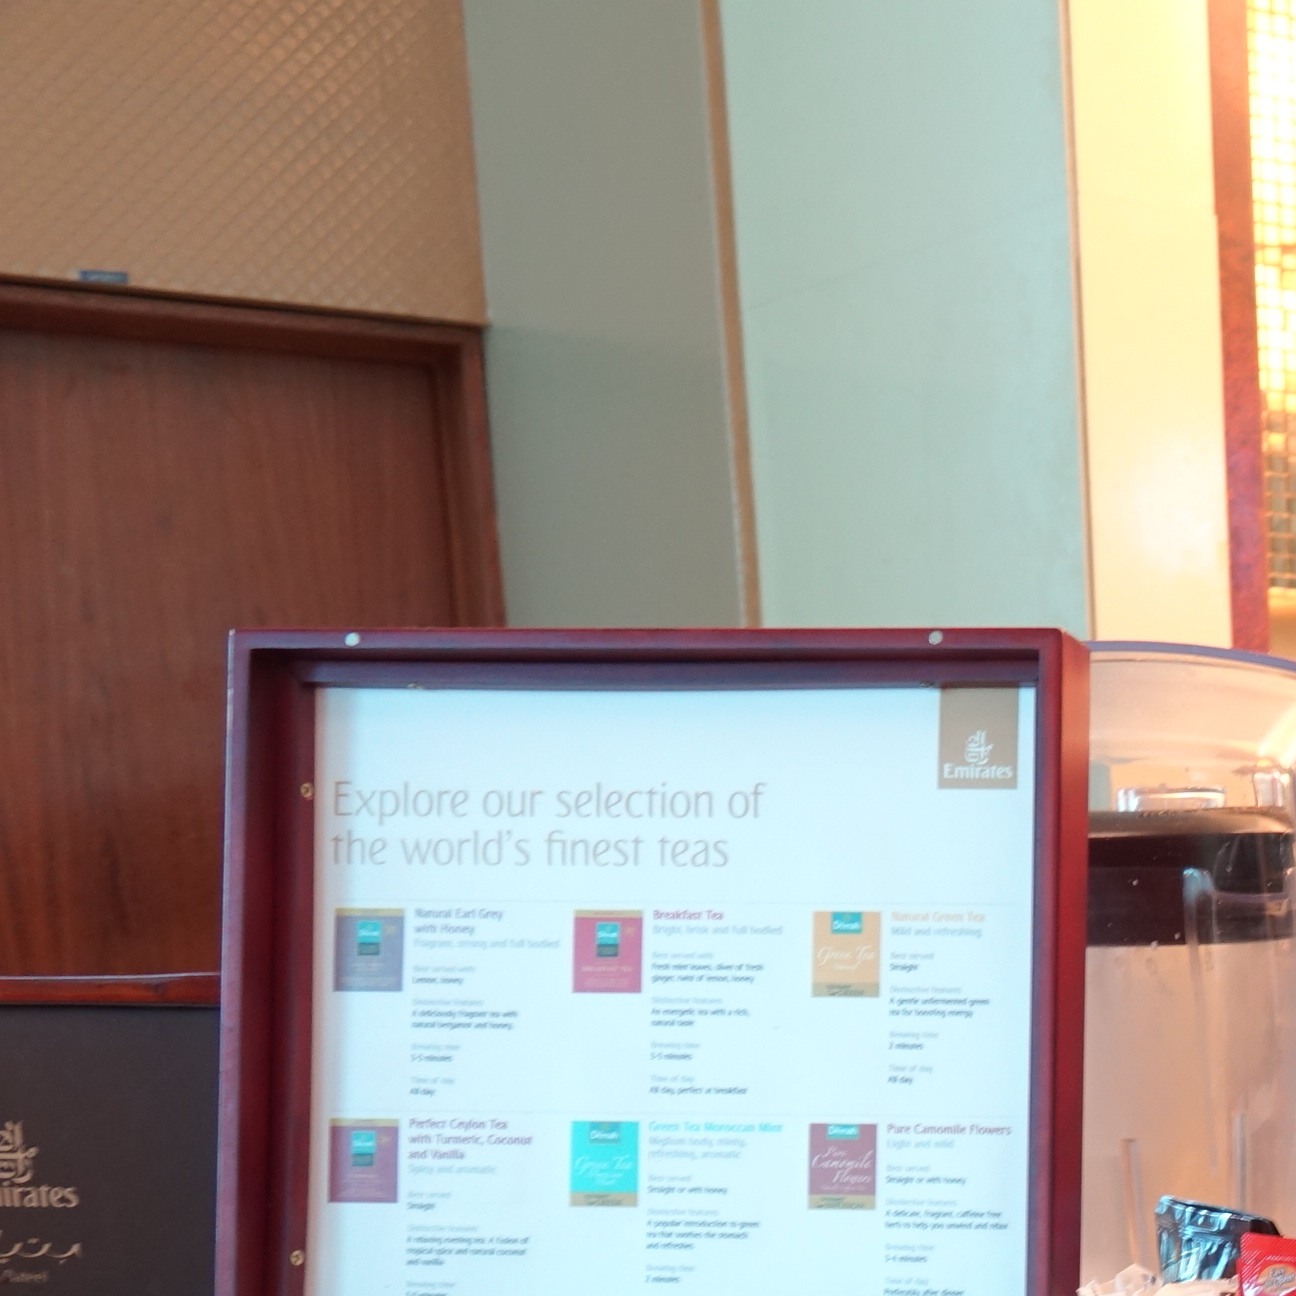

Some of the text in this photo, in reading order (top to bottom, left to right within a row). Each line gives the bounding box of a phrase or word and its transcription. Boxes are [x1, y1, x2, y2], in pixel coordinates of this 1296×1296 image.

[943, 762, 1014, 779] Emirates
[332, 781, 768, 826] Explore our selection of
[331, 830, 731, 867] the world's finest teas
[408, 1118, 509, 1132] Perfect Ceylon Tea
[886, 1122, 1013, 1136] Pure Camomile Flowers
[0, 1184, 80, 1208] irates
